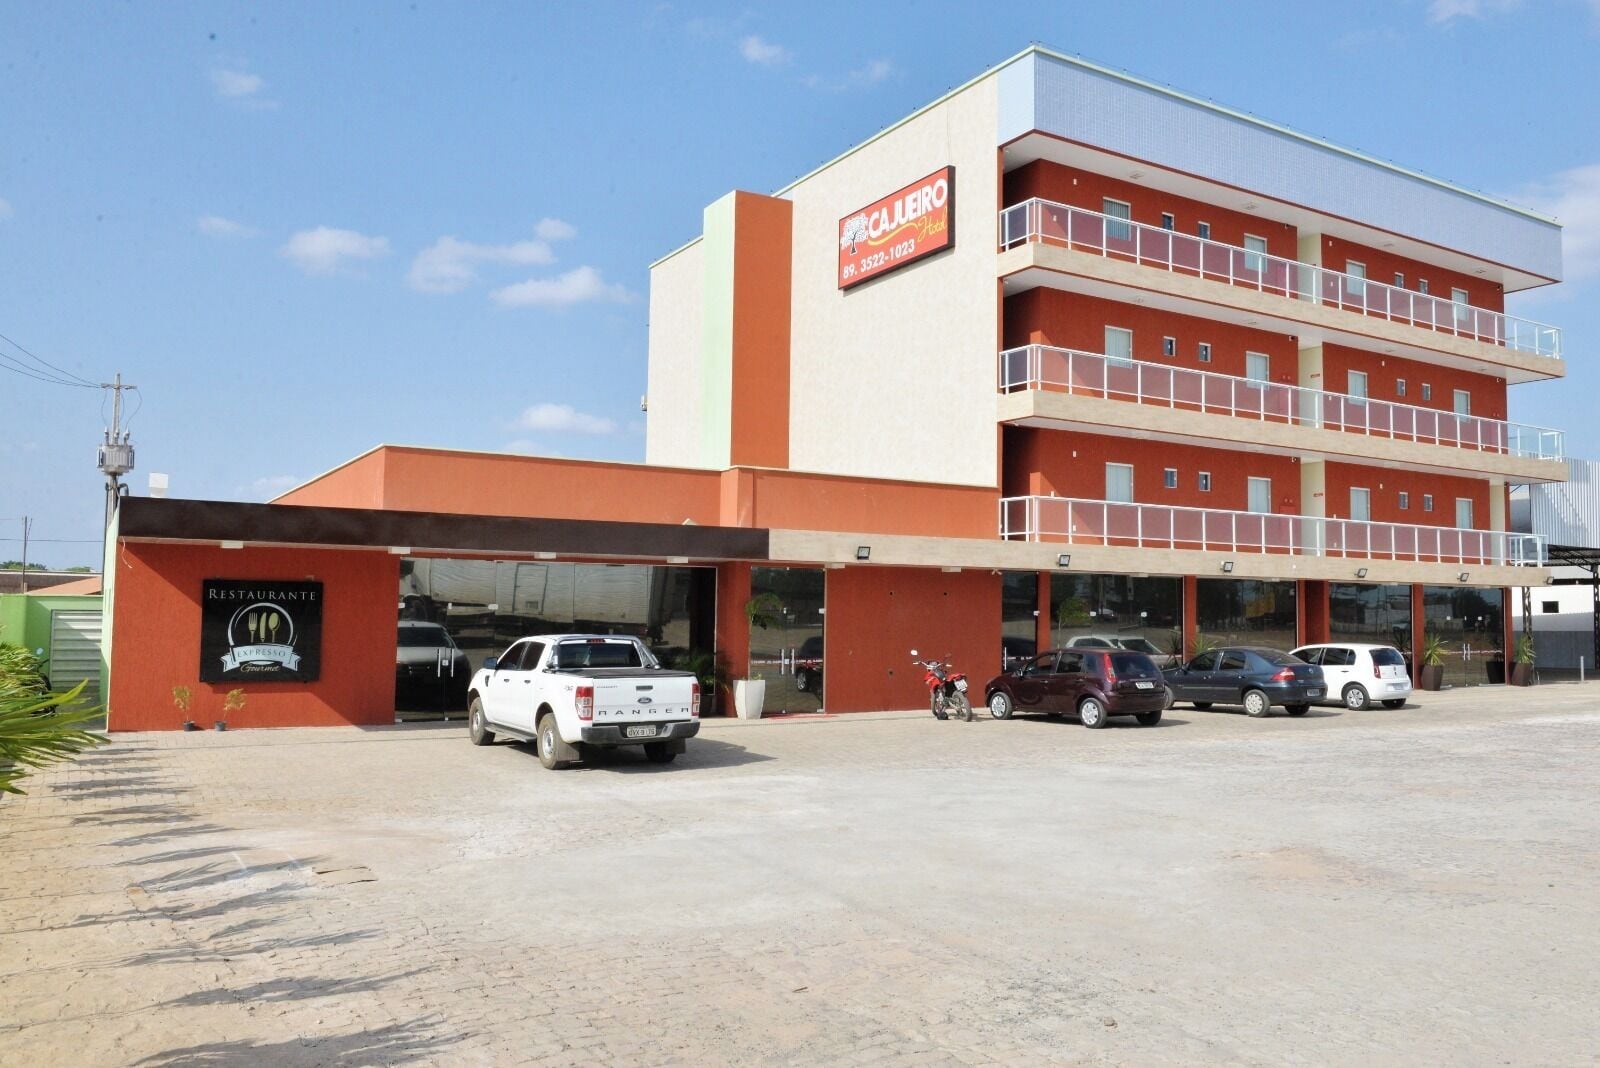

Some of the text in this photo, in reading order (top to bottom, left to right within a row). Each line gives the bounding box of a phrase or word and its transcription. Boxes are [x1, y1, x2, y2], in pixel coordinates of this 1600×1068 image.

[868, 178, 948, 239] CAJUEIRO
[917, 206, 948, 243] Hotel
[843, 238, 915, 279] 89. 3522-1023
[209, 588, 316, 601] RESTAURANTE
[237, 647, 286, 659] EXPRESSO
[240, 662, 281, 674] Gourmet
[598, 707, 689, 716] RANGER
